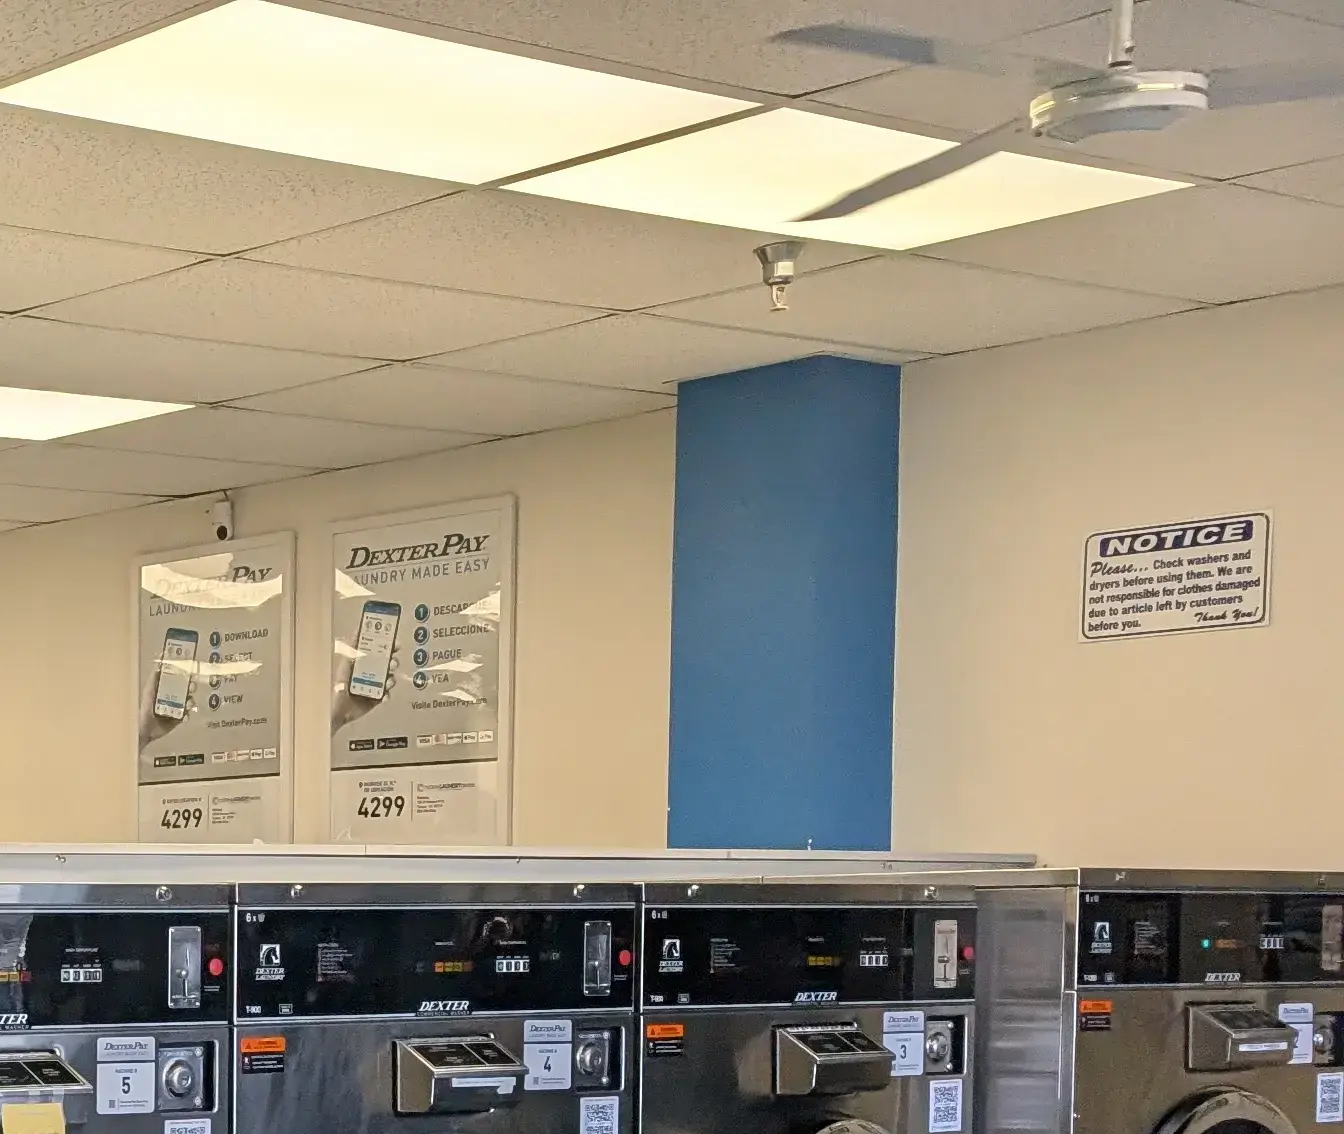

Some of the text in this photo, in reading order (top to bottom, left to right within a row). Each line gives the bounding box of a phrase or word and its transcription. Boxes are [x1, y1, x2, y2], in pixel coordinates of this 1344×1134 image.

[1105, 523, 1247, 556] NOTICE
[346, 533, 490, 570] DEXTERPAY
[1153, 557, 1184, 570] Check
[1187, 554, 1229, 567] washers
[1232, 550, 1251, 562] and
[350, 557, 489, 587] AUNDRY MADE EASY
[1090, 565, 1252, 592] dryers before using them. We are
[1089, 577, 1260, 605] not responsible for clothes damaged
[1088, 594, 1243, 618] due to article left by customers
[1194, 606, 1259, 623] Thank You!
[433, 624, 490, 639] SELECCIONE
[1088, 619, 1141, 632] before you.
[224, 629, 269, 643] DOWNLOAD
[432, 649, 463, 661] PAGUE
[431, 673, 450, 684] VEA
[223, 694, 243, 704] VIEW
[357, 796, 405, 818] 4299
[161, 808, 203, 829] 4299
[246, 913, 251, 923] 6
[795, 992, 837, 1001] DEXTER
[419, 1000, 469, 1011] DEXTER
[900, 1045, 907, 1059] 3
[543, 1056, 551, 1072] 4
[121, 1076, 131, 1094] 5
